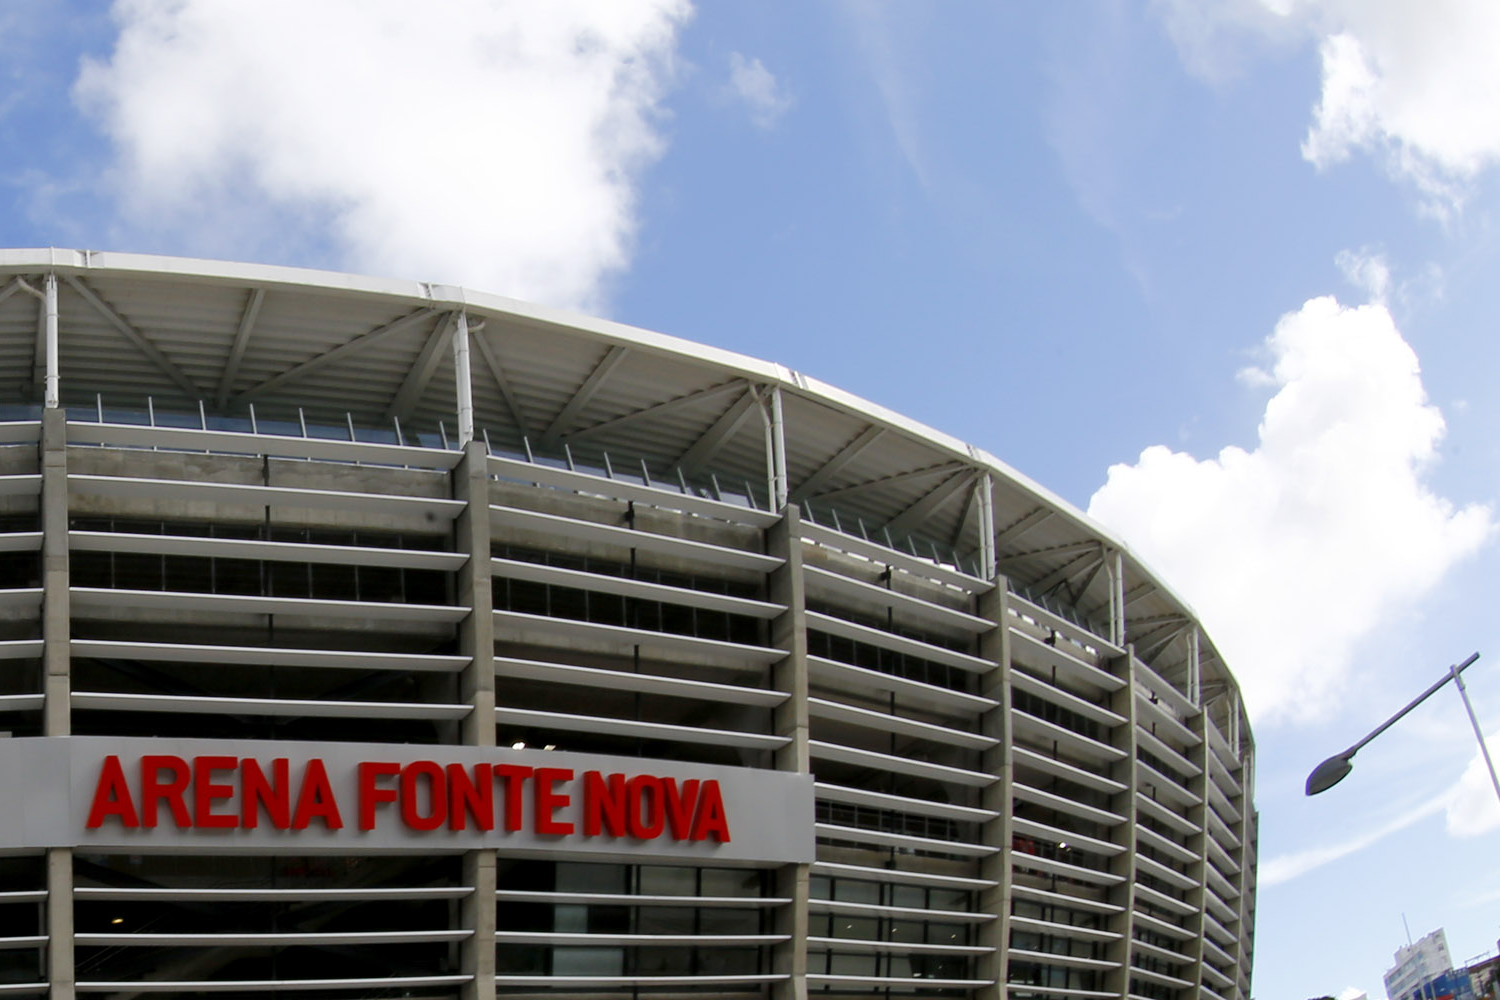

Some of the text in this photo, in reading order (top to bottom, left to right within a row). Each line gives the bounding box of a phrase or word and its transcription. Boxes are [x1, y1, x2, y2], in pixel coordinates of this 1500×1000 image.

[86, 755, 731, 843] ARENA FONTE NOVA
